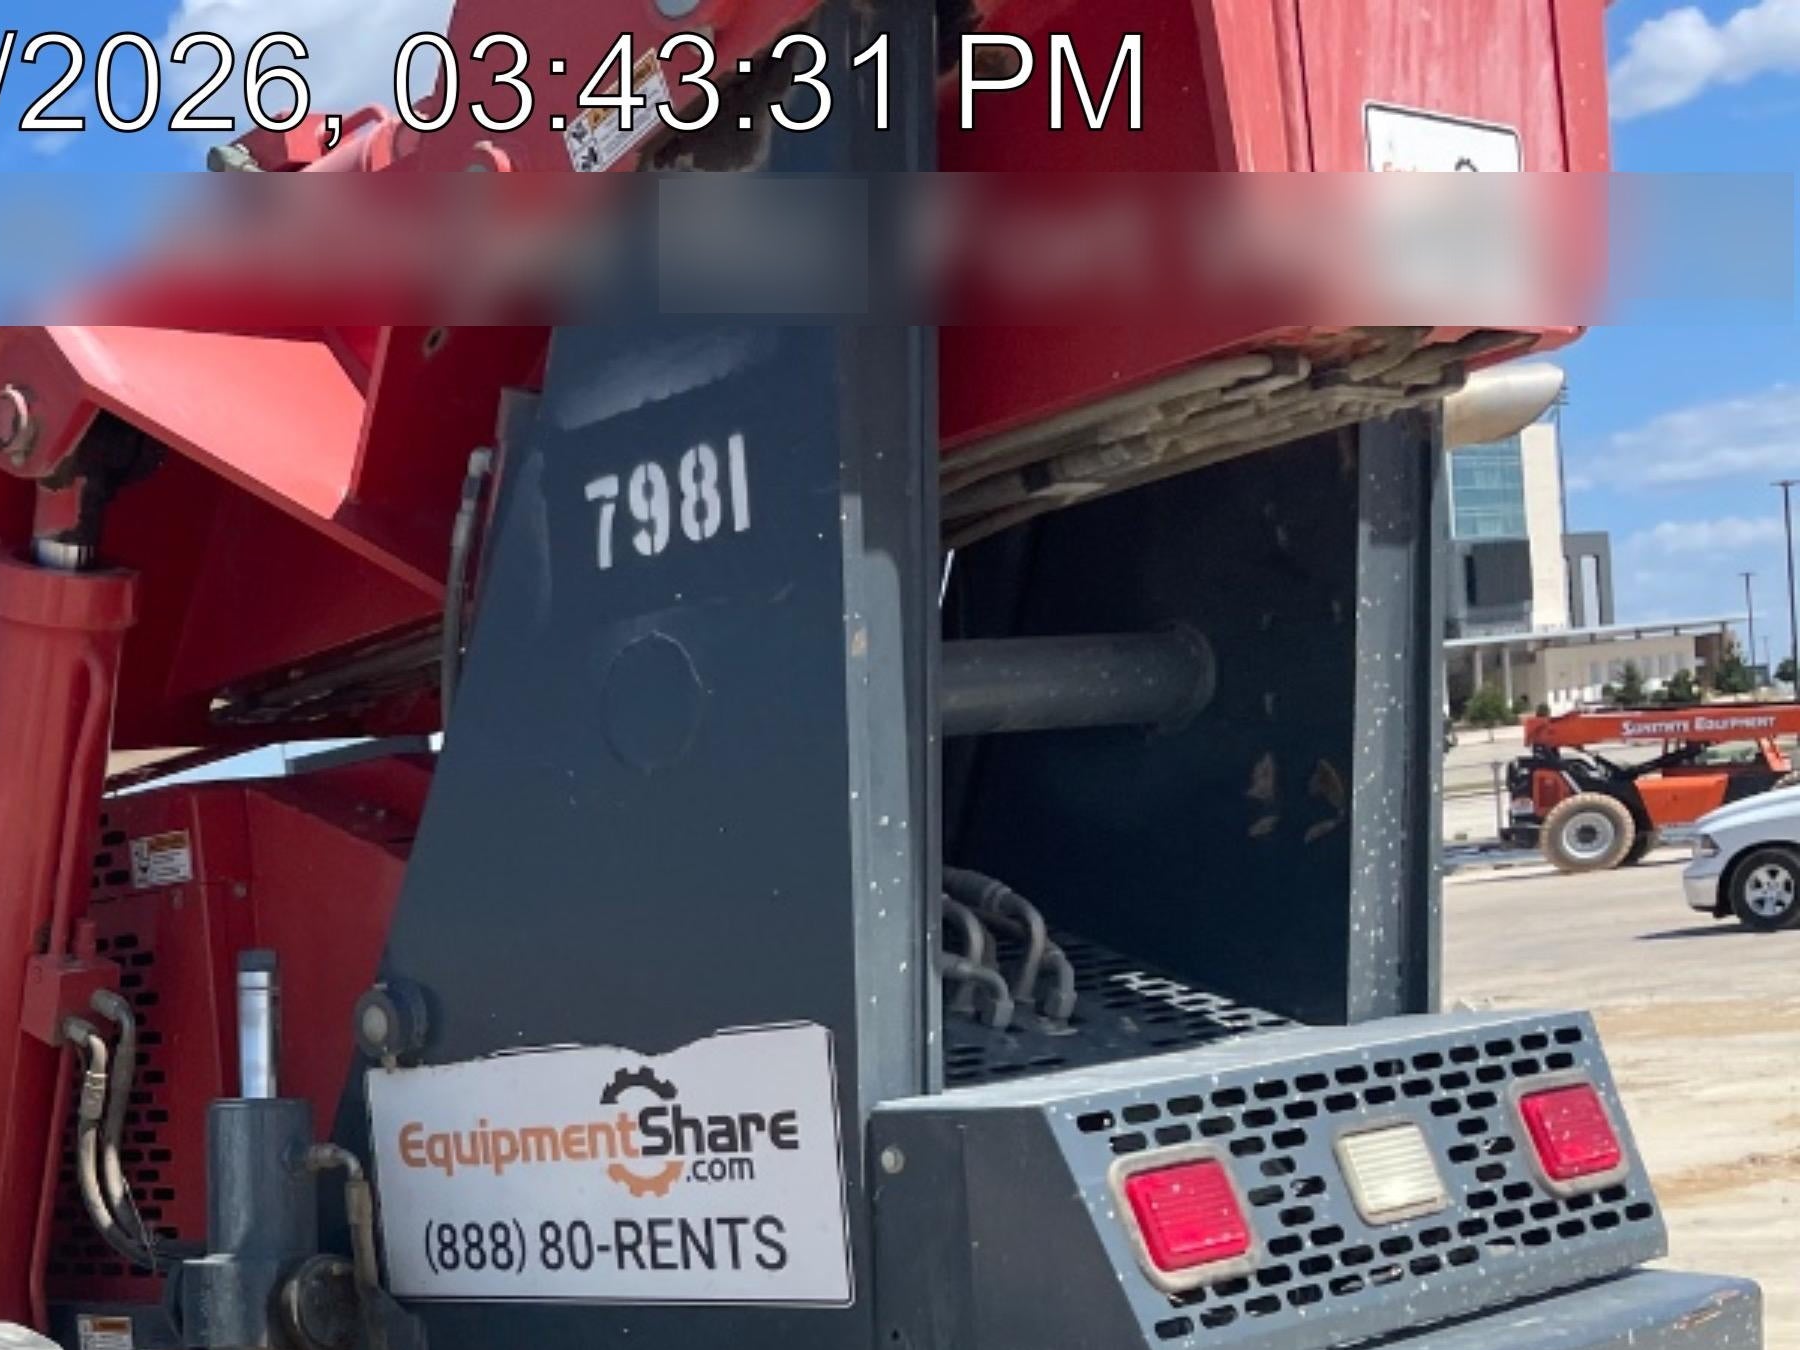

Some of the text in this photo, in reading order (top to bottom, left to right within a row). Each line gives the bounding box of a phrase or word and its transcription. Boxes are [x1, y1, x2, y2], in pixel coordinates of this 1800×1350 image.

[584, 434, 751, 570] 7981
[398, 1105, 800, 1177] EquipmentShare
[685, 1157, 756, 1184] .com
[423, 1215, 789, 1276] (888) 80-RENTS
